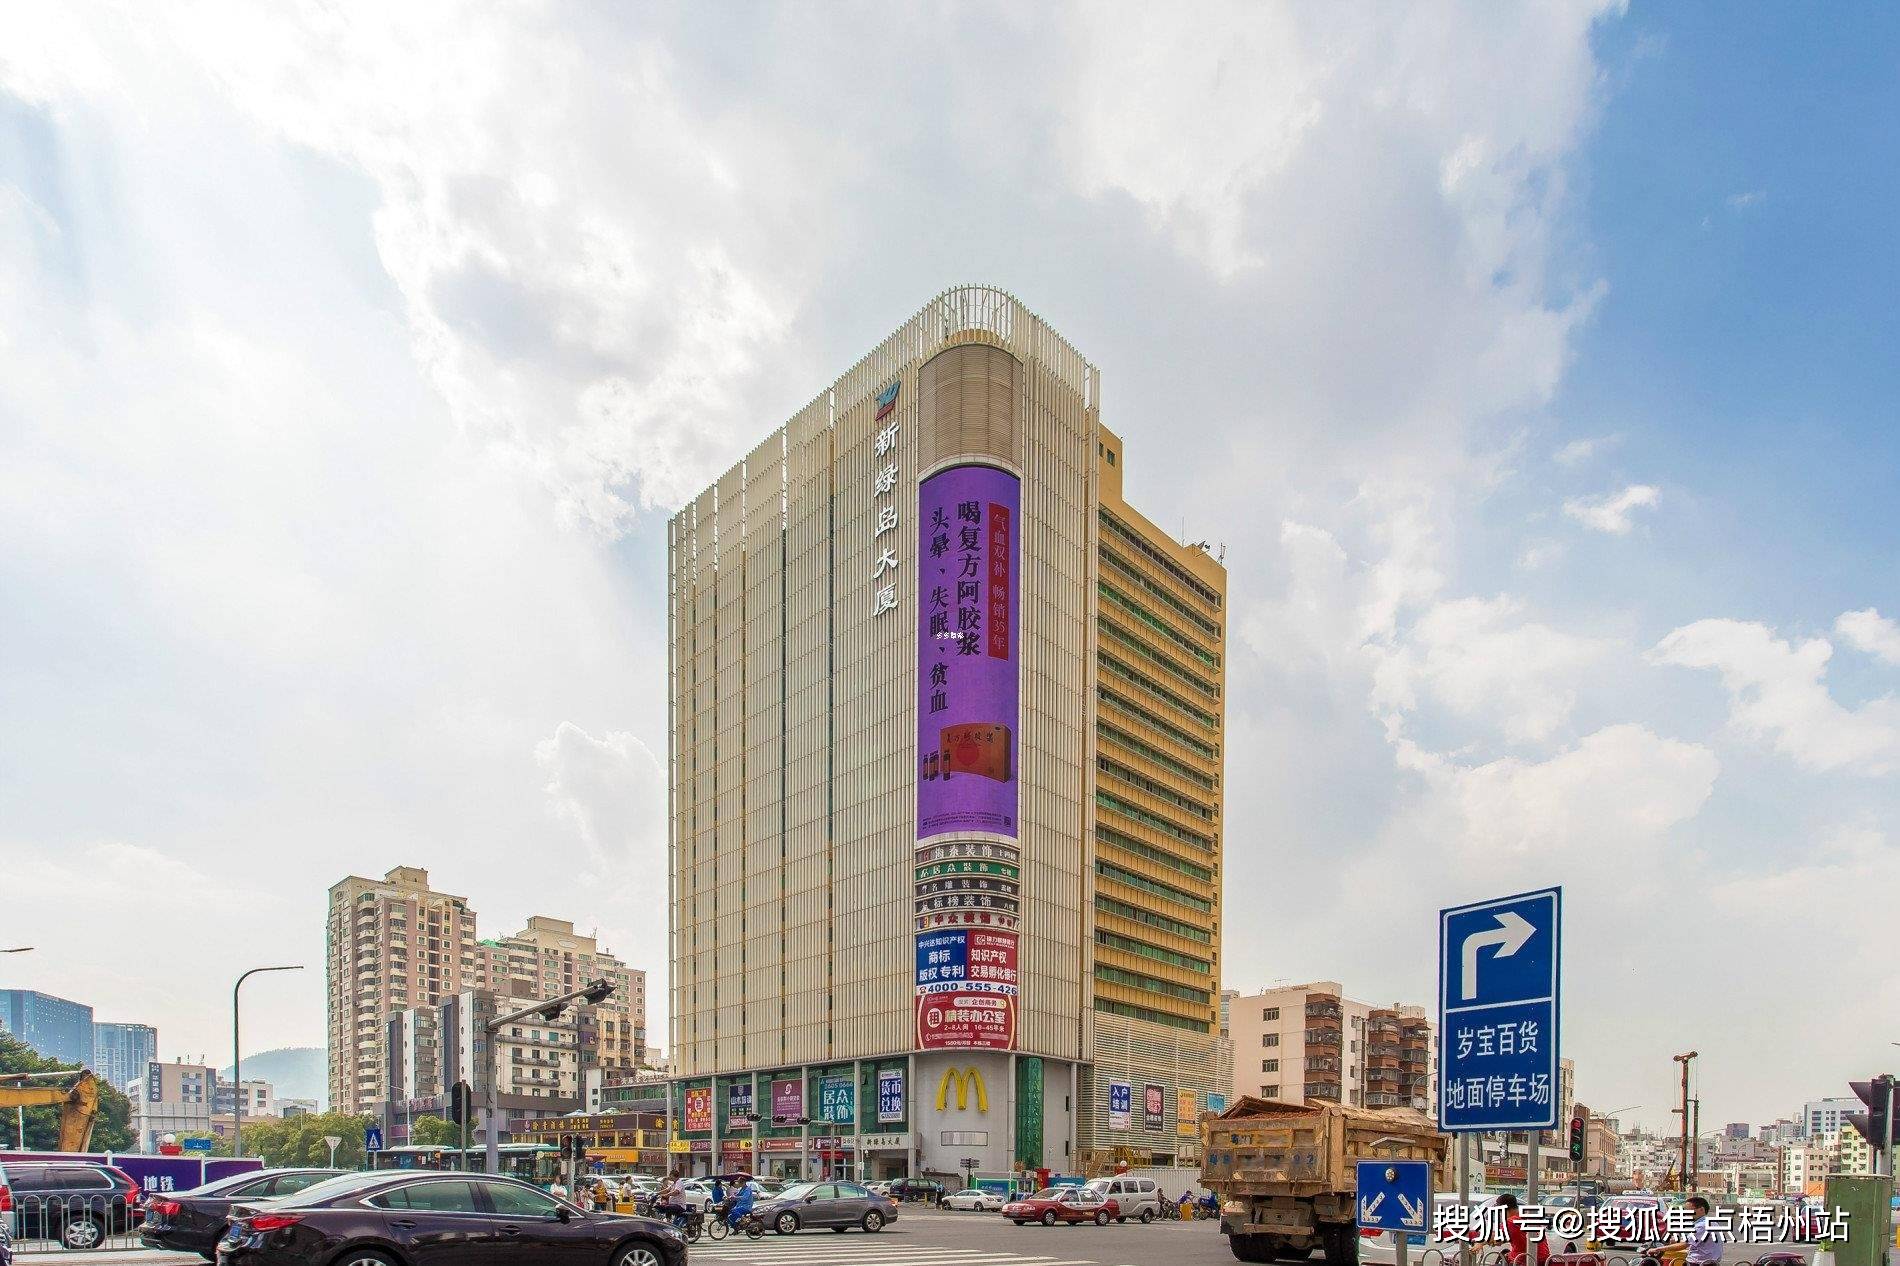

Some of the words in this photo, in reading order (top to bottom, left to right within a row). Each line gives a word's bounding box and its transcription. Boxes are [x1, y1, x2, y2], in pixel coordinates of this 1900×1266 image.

[872, 421, 900, 617] 新绿岛大厦
[957, 501, 981, 656] 喝复方阿胶浆
[933, 895, 992, 908] 标榜装饰
[928, 949, 951, 964] 商标
[971, 949, 1007, 964] 知识产权
[919, 967, 937, 981] 版权
[940, 965, 965, 978] 专利
[929, 1010, 940, 1025] 租
[1457, 1020, 1538, 1060] 岁宝百货
[881, 1080, 901, 1095] 货币
[1112, 1086, 1128, 1097] 入户
[1446, 1073, 1549, 1110] 地面停车场
[824, 1089, 849, 1104] 居众
[881, 1097, 901, 1112] 兑换
[143, 1175, 175, 1191] 地铁
